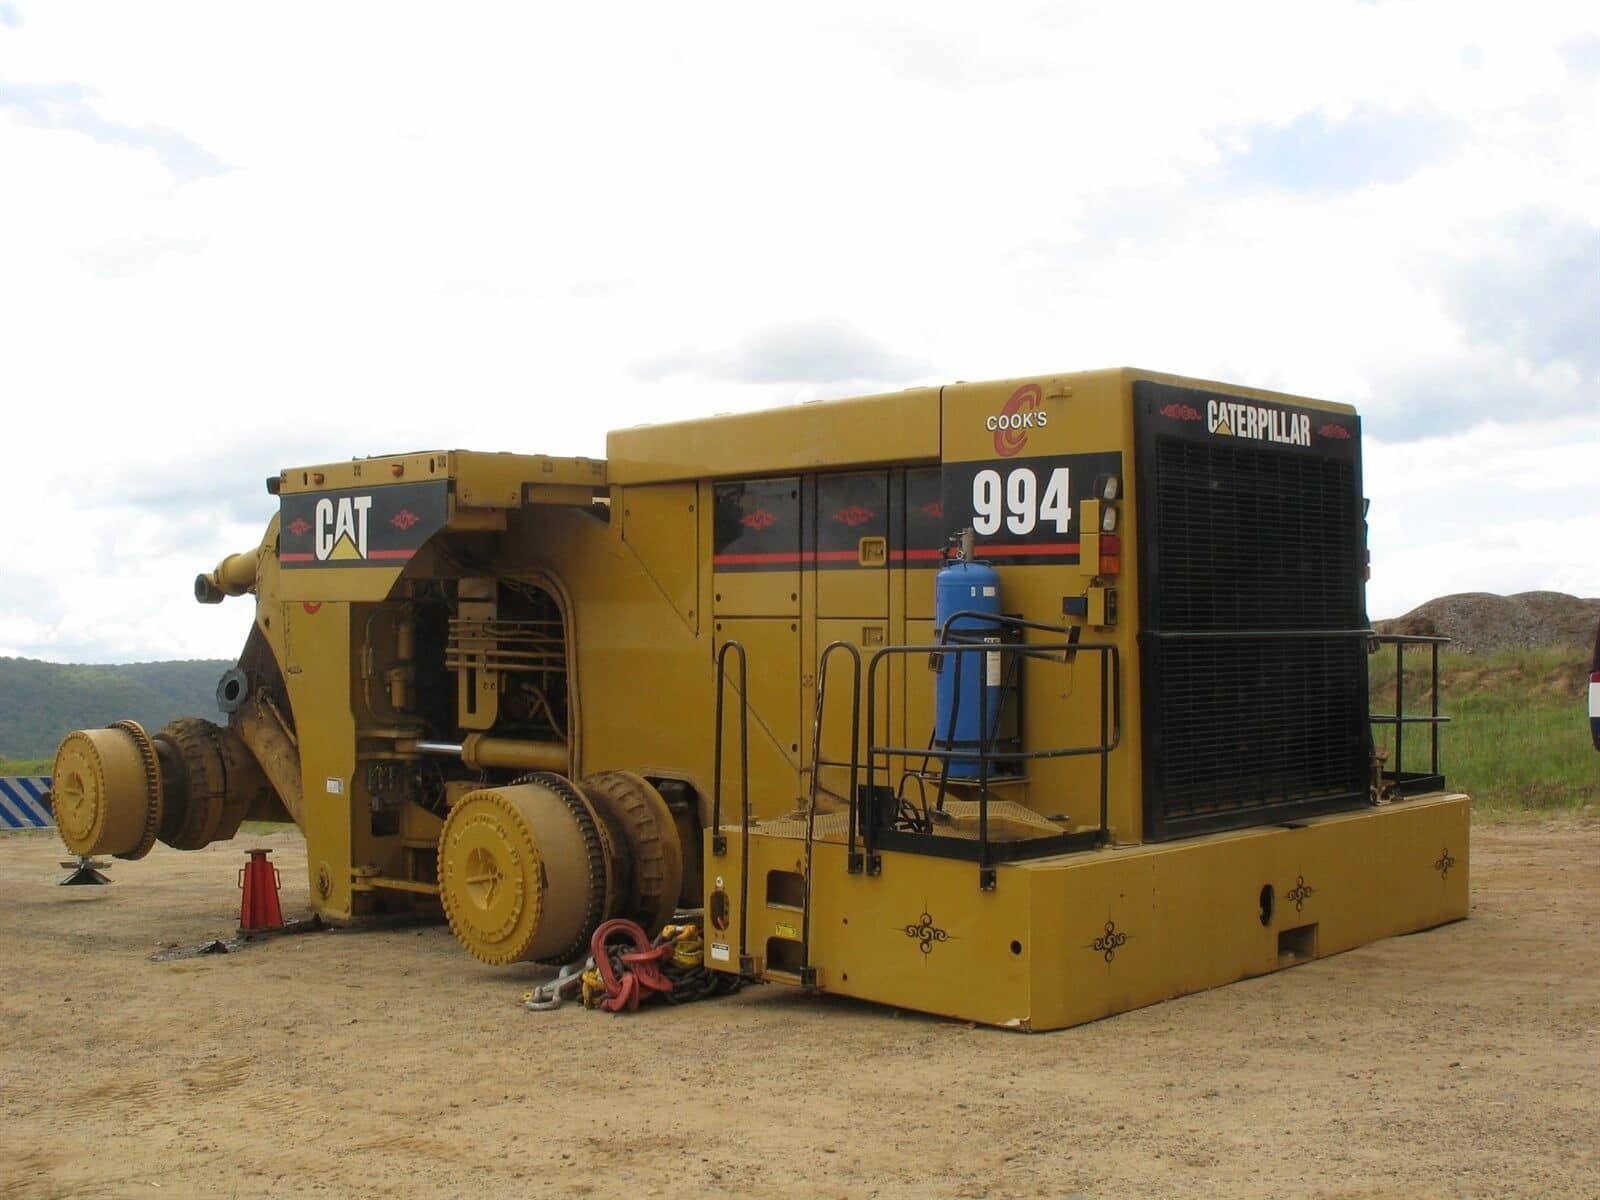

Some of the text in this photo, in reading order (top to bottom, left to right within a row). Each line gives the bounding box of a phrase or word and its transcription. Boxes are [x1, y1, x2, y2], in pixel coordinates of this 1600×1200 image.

[986, 411, 1047, 432] COOK'S
[1207, 400, 1311, 447] CATERPILLAR
[315, 495, 372, 560] CAT
[972, 467, 1072, 535] 994
